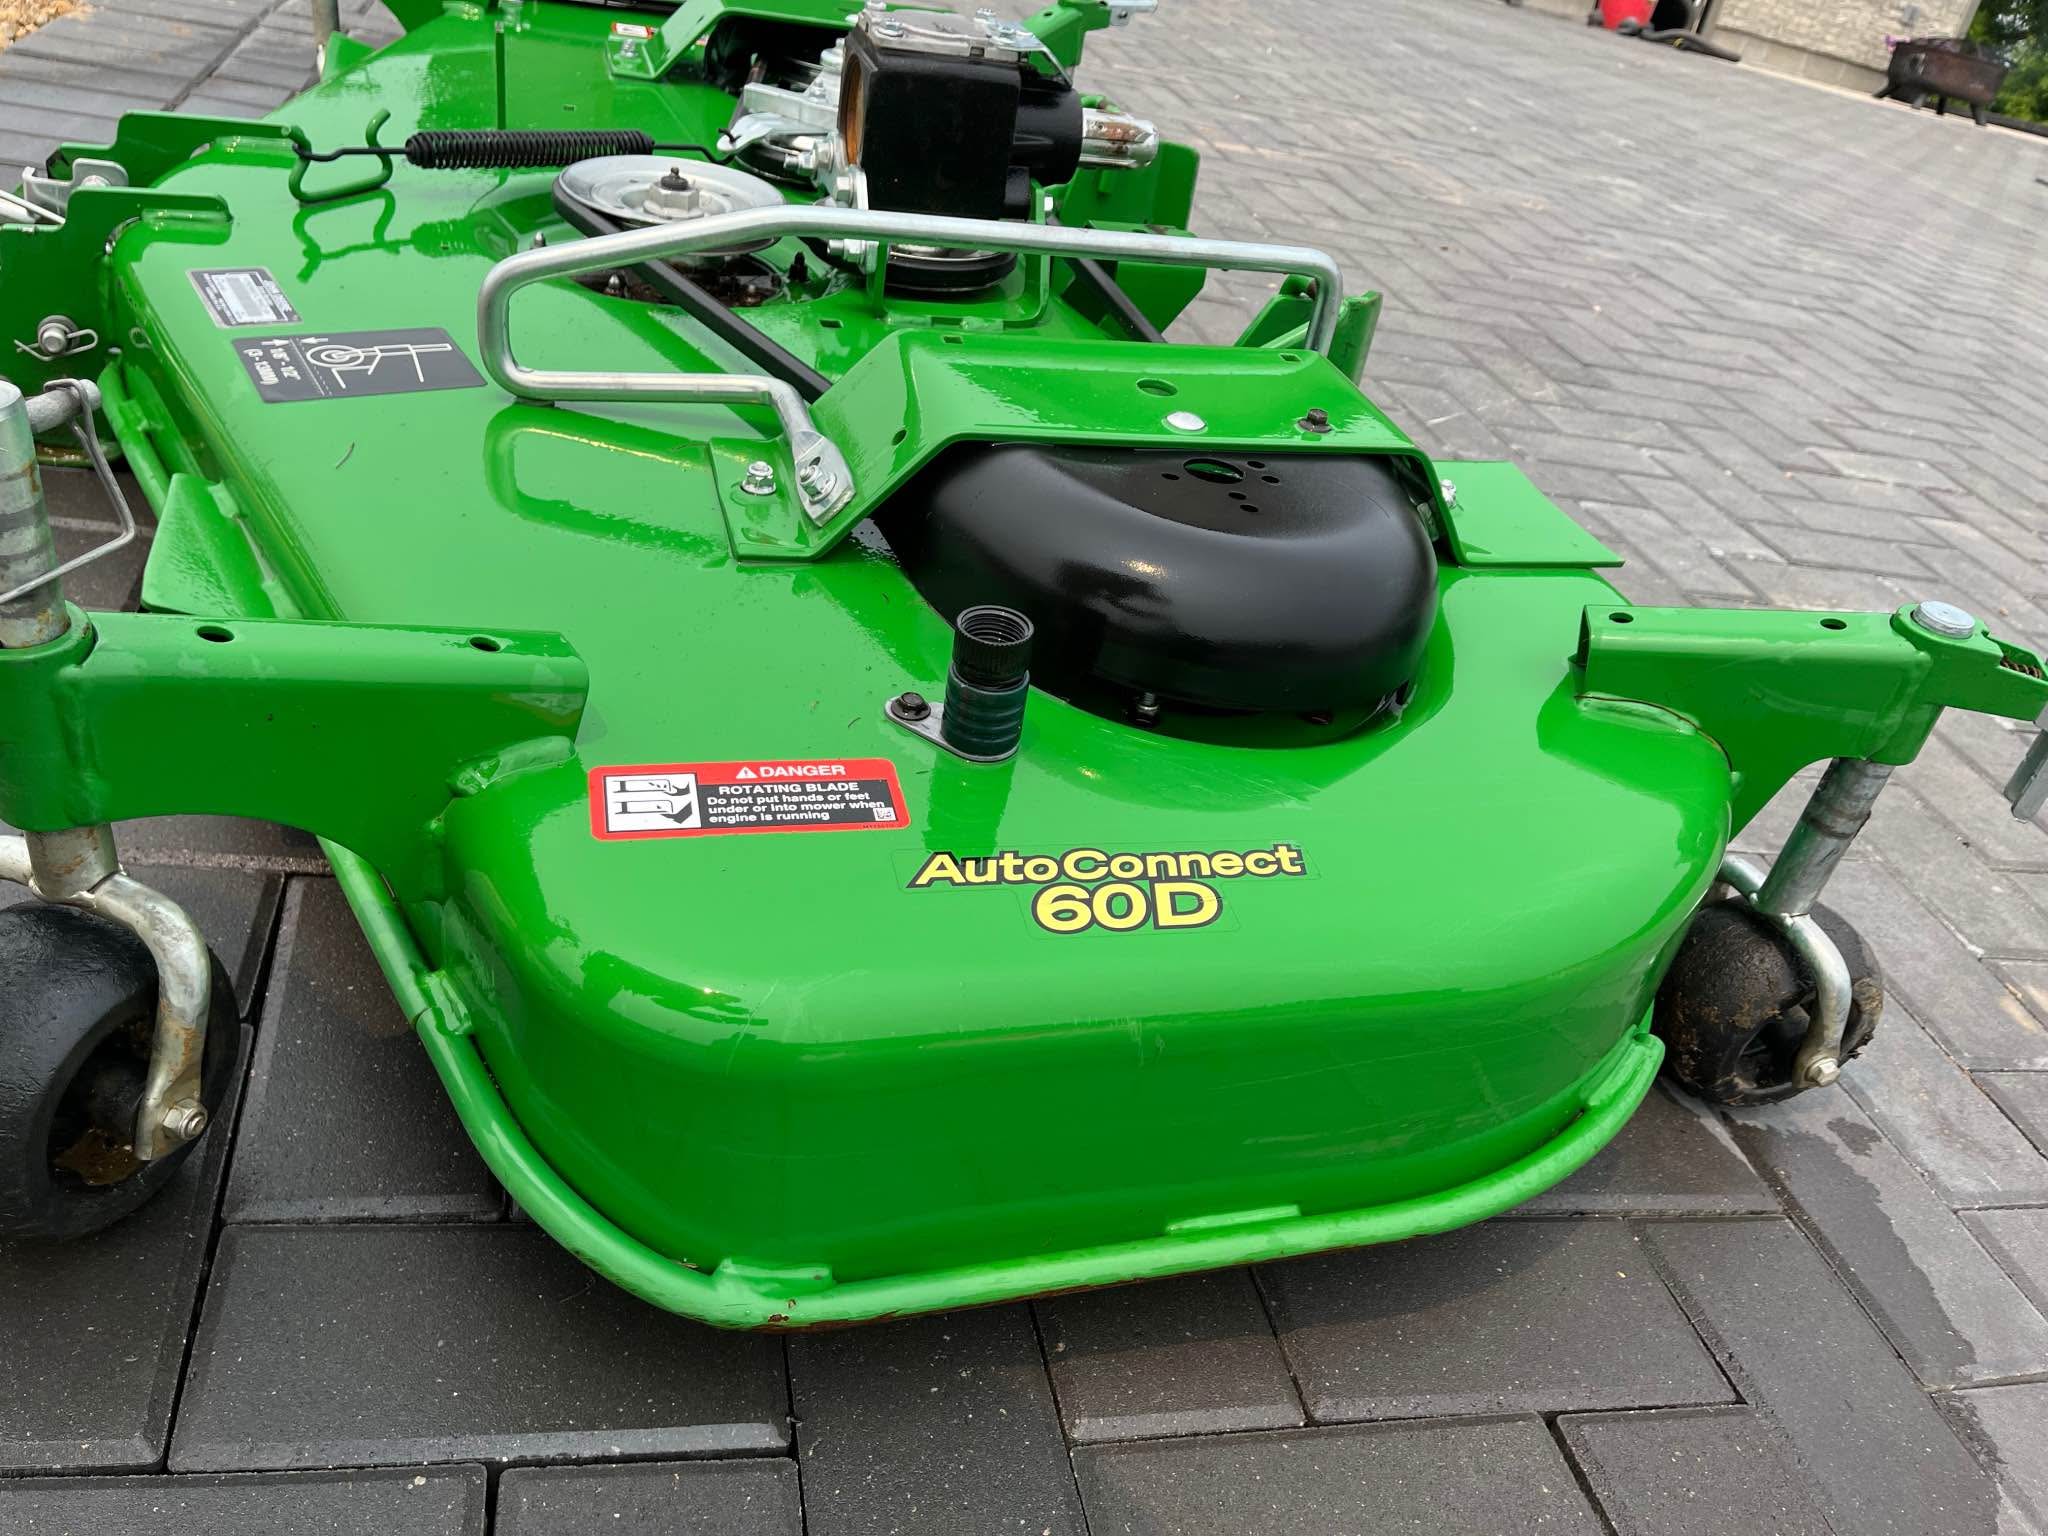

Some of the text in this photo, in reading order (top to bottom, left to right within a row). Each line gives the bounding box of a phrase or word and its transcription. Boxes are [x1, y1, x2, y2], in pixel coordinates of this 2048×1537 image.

[759, 765, 846, 778] DANGER
[718, 782, 860, 795] ROTATING BLADE
[707, 796, 728, 805] Do
[730, 796, 754, 804] not
[756, 795, 780, 805] put
[782, 793, 825, 803] hands
[844, 792, 871, 800] feet
[708, 805, 749, 814] under
[770, 803, 798, 812] into
[800, 802, 846, 811] mower
[849, 801, 885, 809] when
[708, 811, 831, 825] engine is running
[908, 844, 1306, 888] AutoConnect
[1032, 881, 1222, 933] 60D
